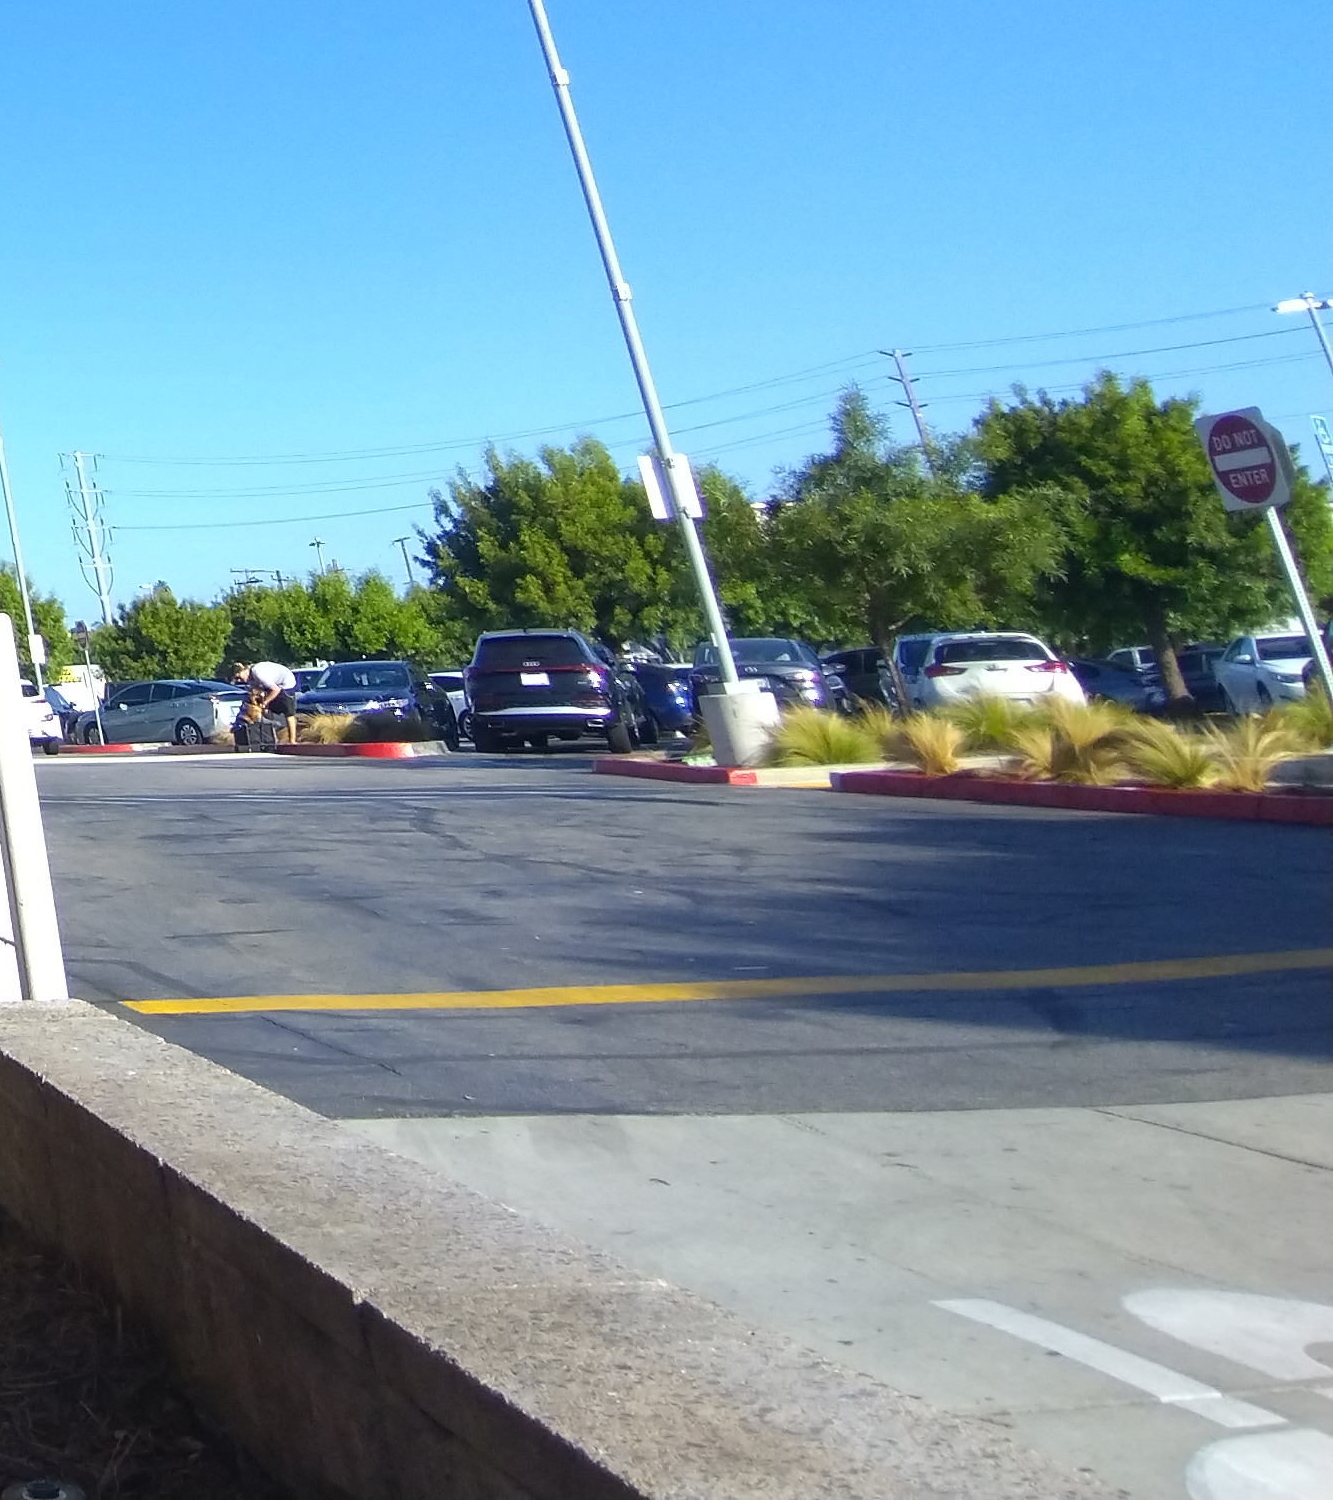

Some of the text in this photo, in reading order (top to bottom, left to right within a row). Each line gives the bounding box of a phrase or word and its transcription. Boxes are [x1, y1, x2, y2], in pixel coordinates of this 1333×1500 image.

[1211, 430, 1259, 451] DO NOT
[1229, 469, 1270, 488] ENTER
